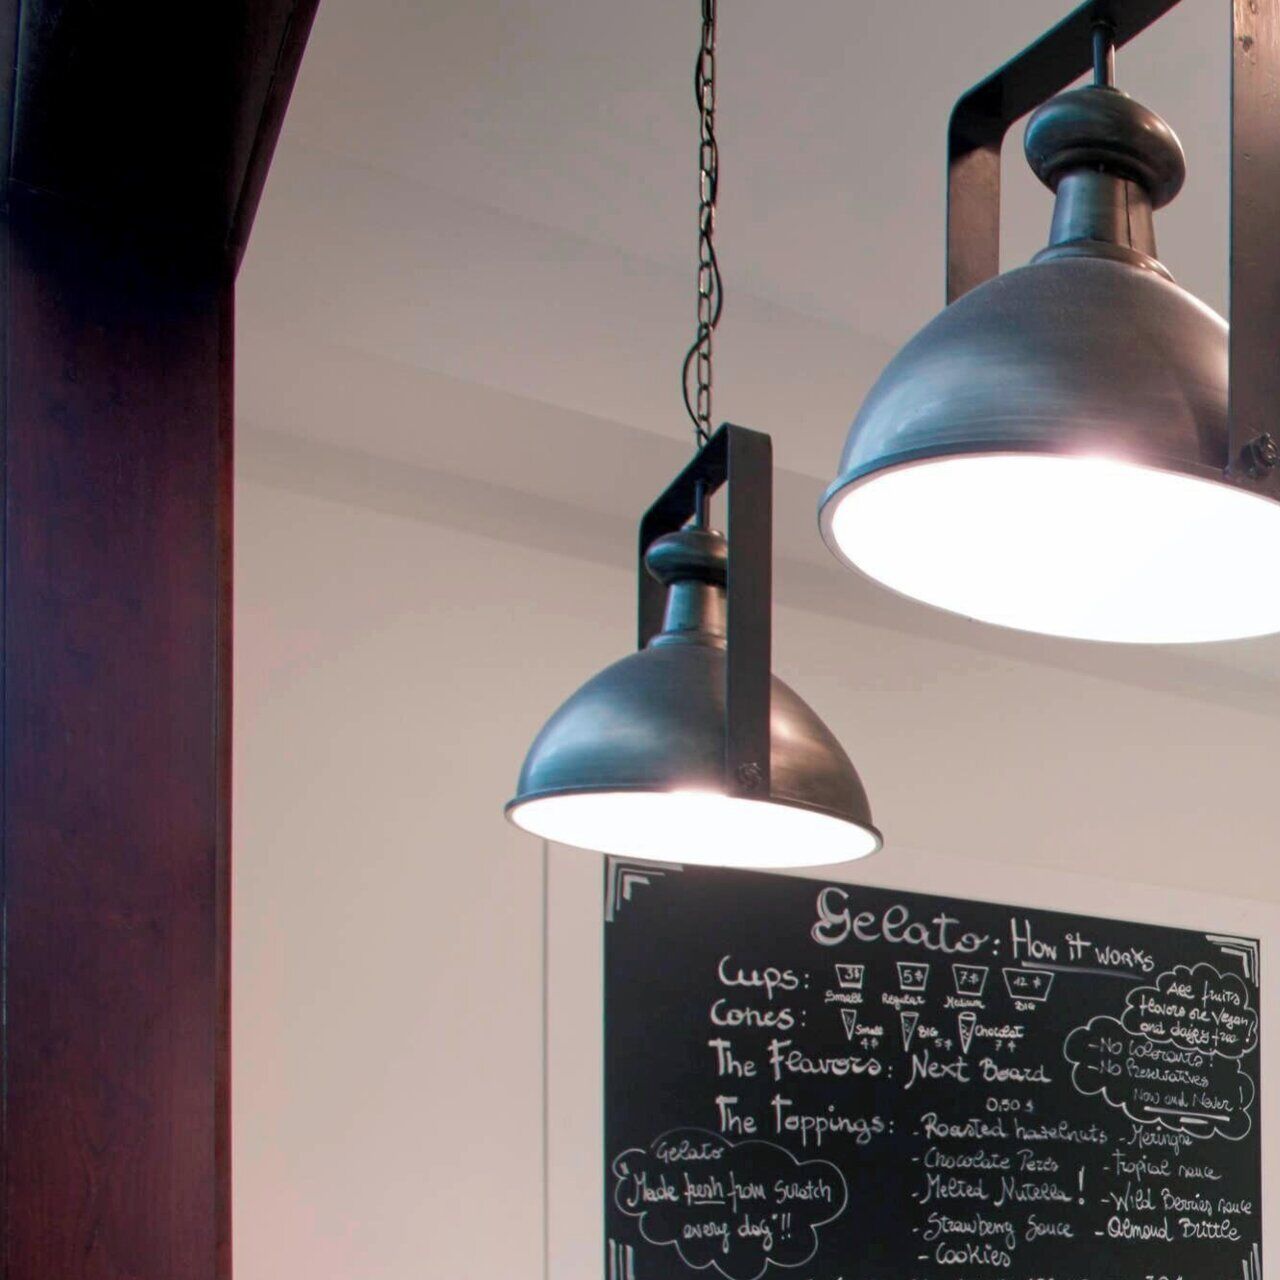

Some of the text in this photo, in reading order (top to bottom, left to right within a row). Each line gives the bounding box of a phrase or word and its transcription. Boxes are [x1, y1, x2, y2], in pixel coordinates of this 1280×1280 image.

[1010, 917, 1058, 961] How
[1065, 932, 1092, 960] it
[718, 954, 810, 1000] Cups:
[710, 998, 806, 1030] Cones:
[708, 1038, 1052, 1089] The Flavors: Next Board
[716, 1093, 894, 1145] The Toppings:
[1015, 1119, 1109, 1144] hazelnuts
[656, 1140, 724, 1162] Gelato
